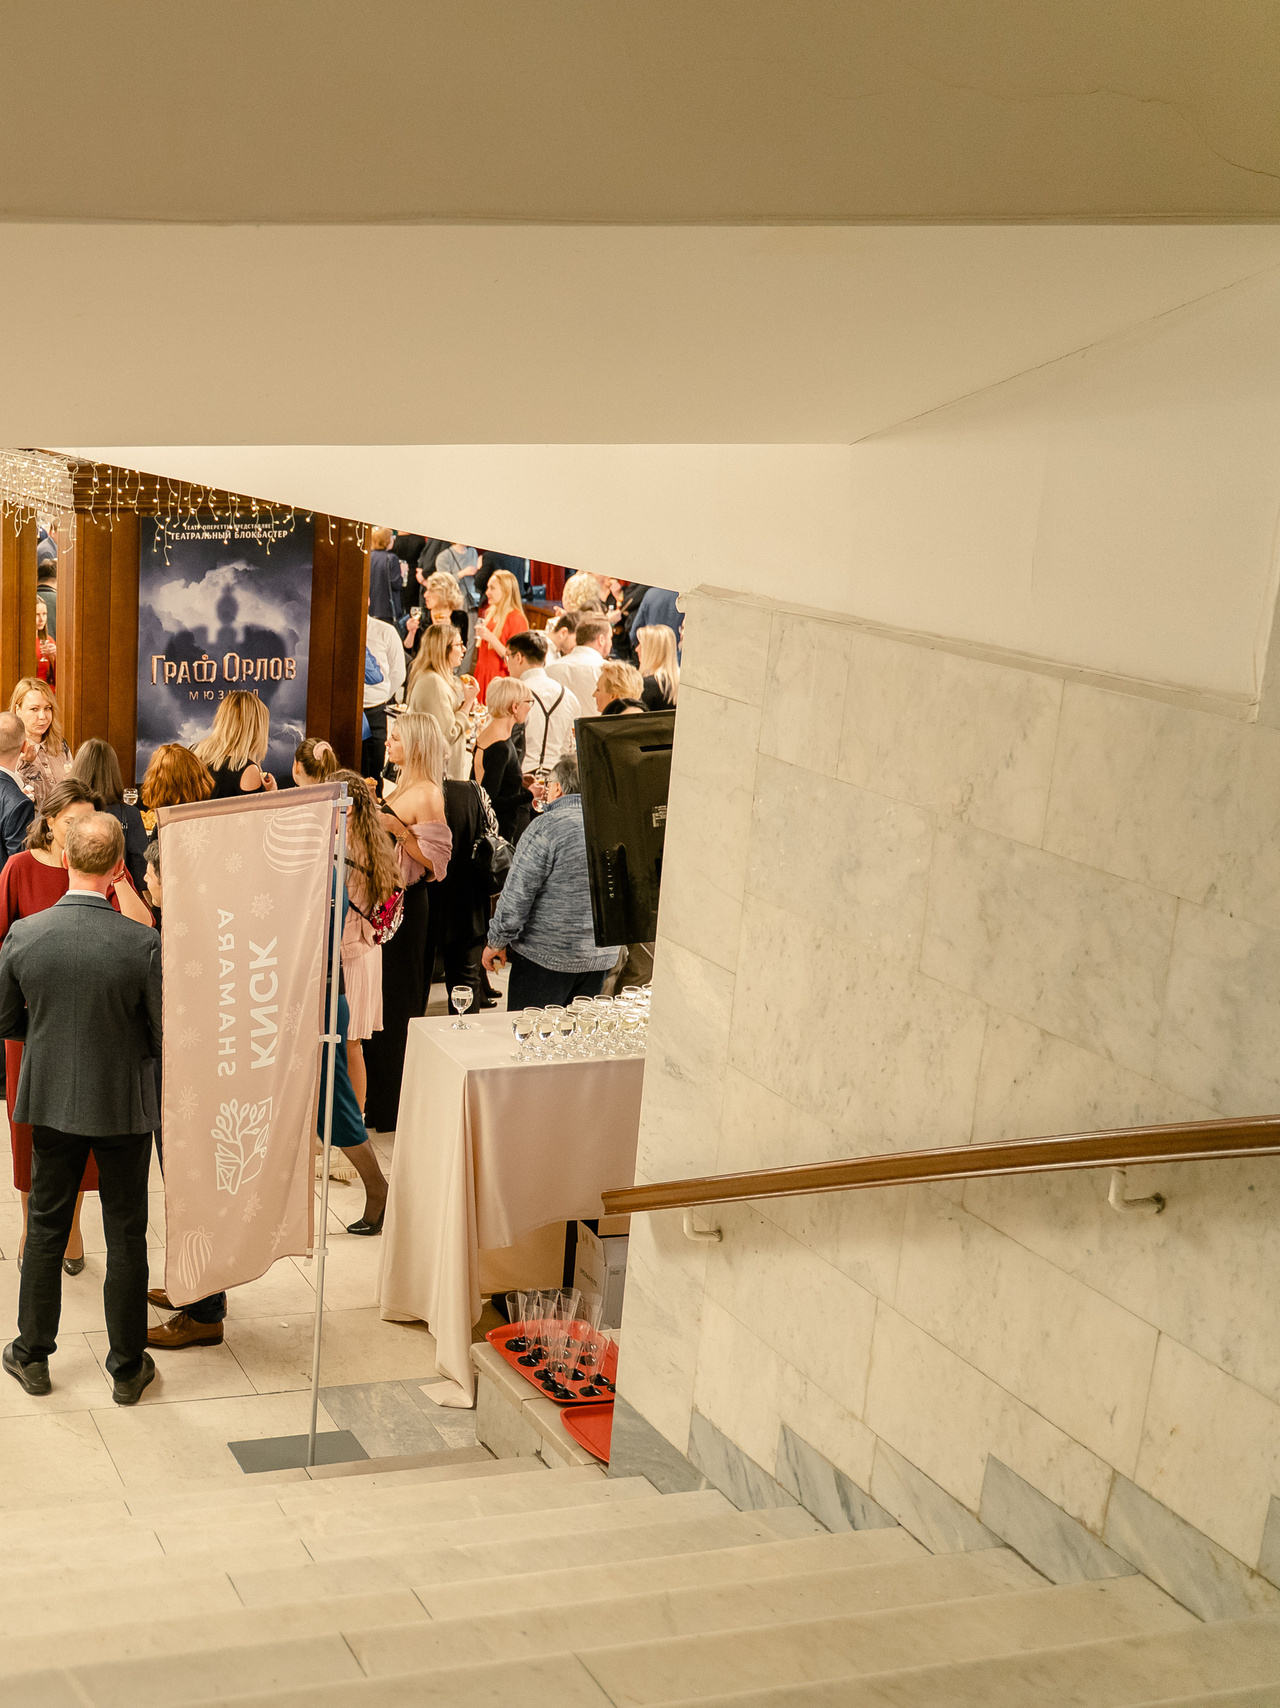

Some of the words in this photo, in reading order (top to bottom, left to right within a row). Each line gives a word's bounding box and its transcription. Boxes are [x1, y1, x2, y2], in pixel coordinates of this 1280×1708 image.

[171, 530, 231, 540] ТЕАТРАЛЬНЫЙ
[234, 530, 288, 539] БЛОКБАСТЕР
[189, 689, 259, 701] МЮЗЛ
